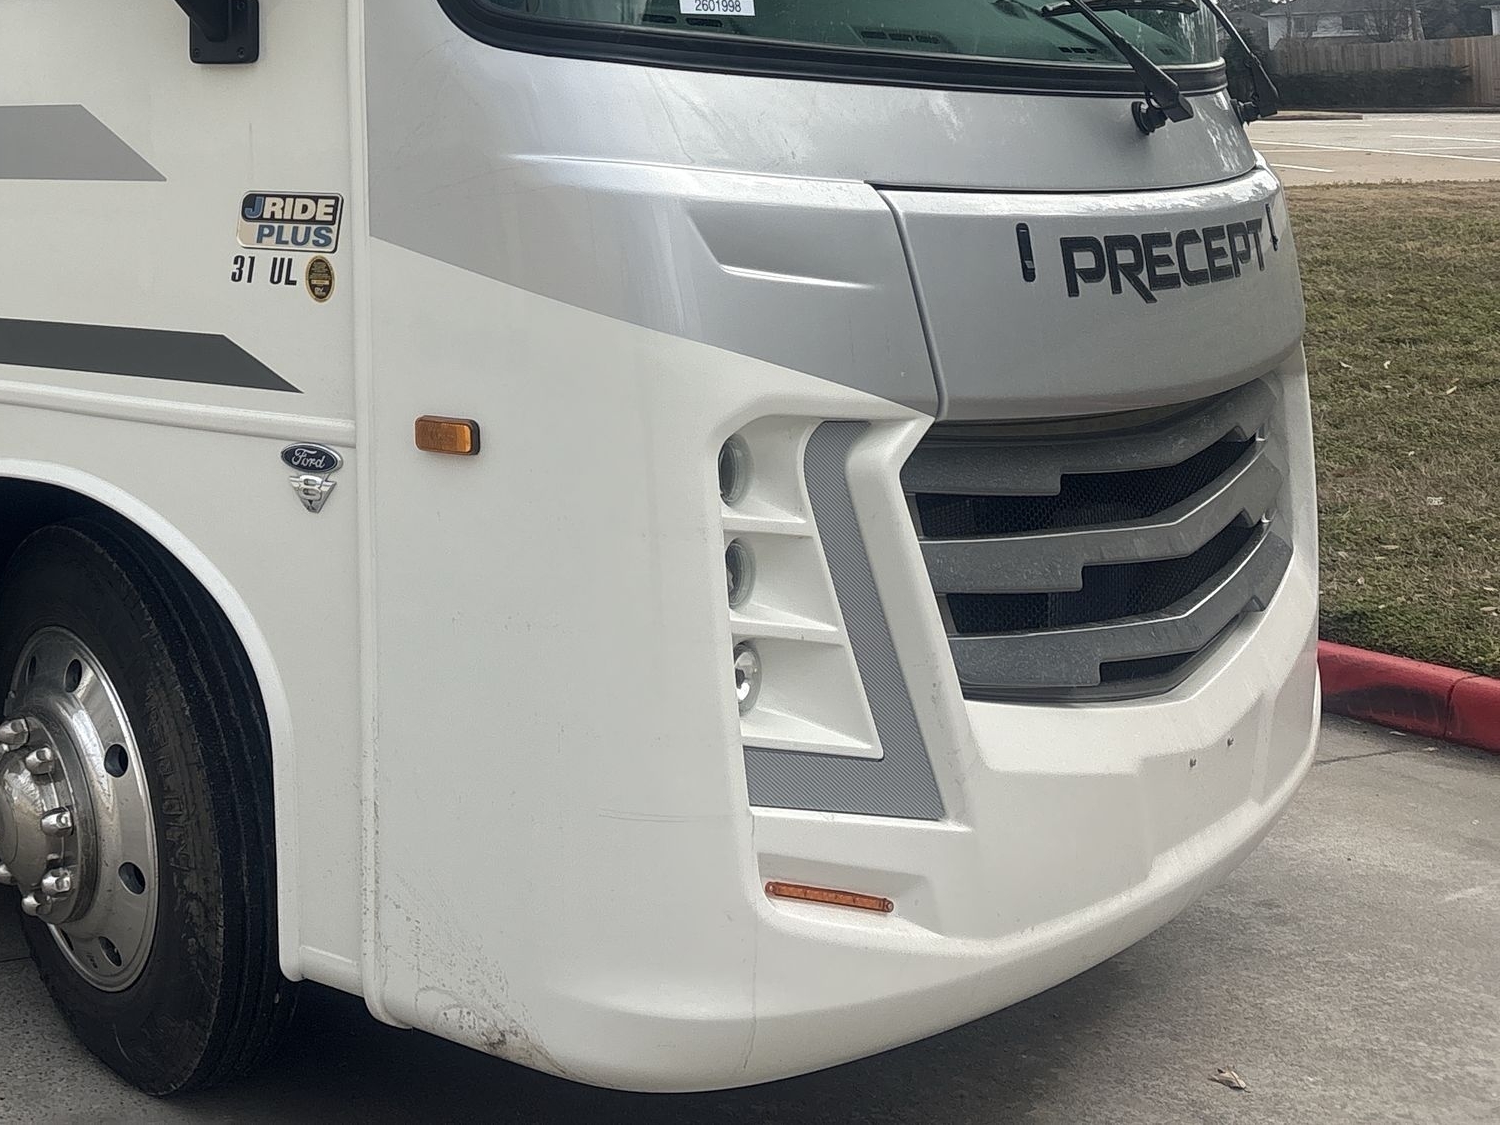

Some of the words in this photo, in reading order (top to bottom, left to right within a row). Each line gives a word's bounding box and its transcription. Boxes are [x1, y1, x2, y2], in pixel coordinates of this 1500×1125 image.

[244, 196, 336, 222] JRIDE
[255, 224, 333, 248] PLUS
[230, 254, 256, 284] 31
[268, 256, 298, 286] UL
[1059, 217, 1265, 304] PRECEPT
[291, 447, 326, 469] Ford
